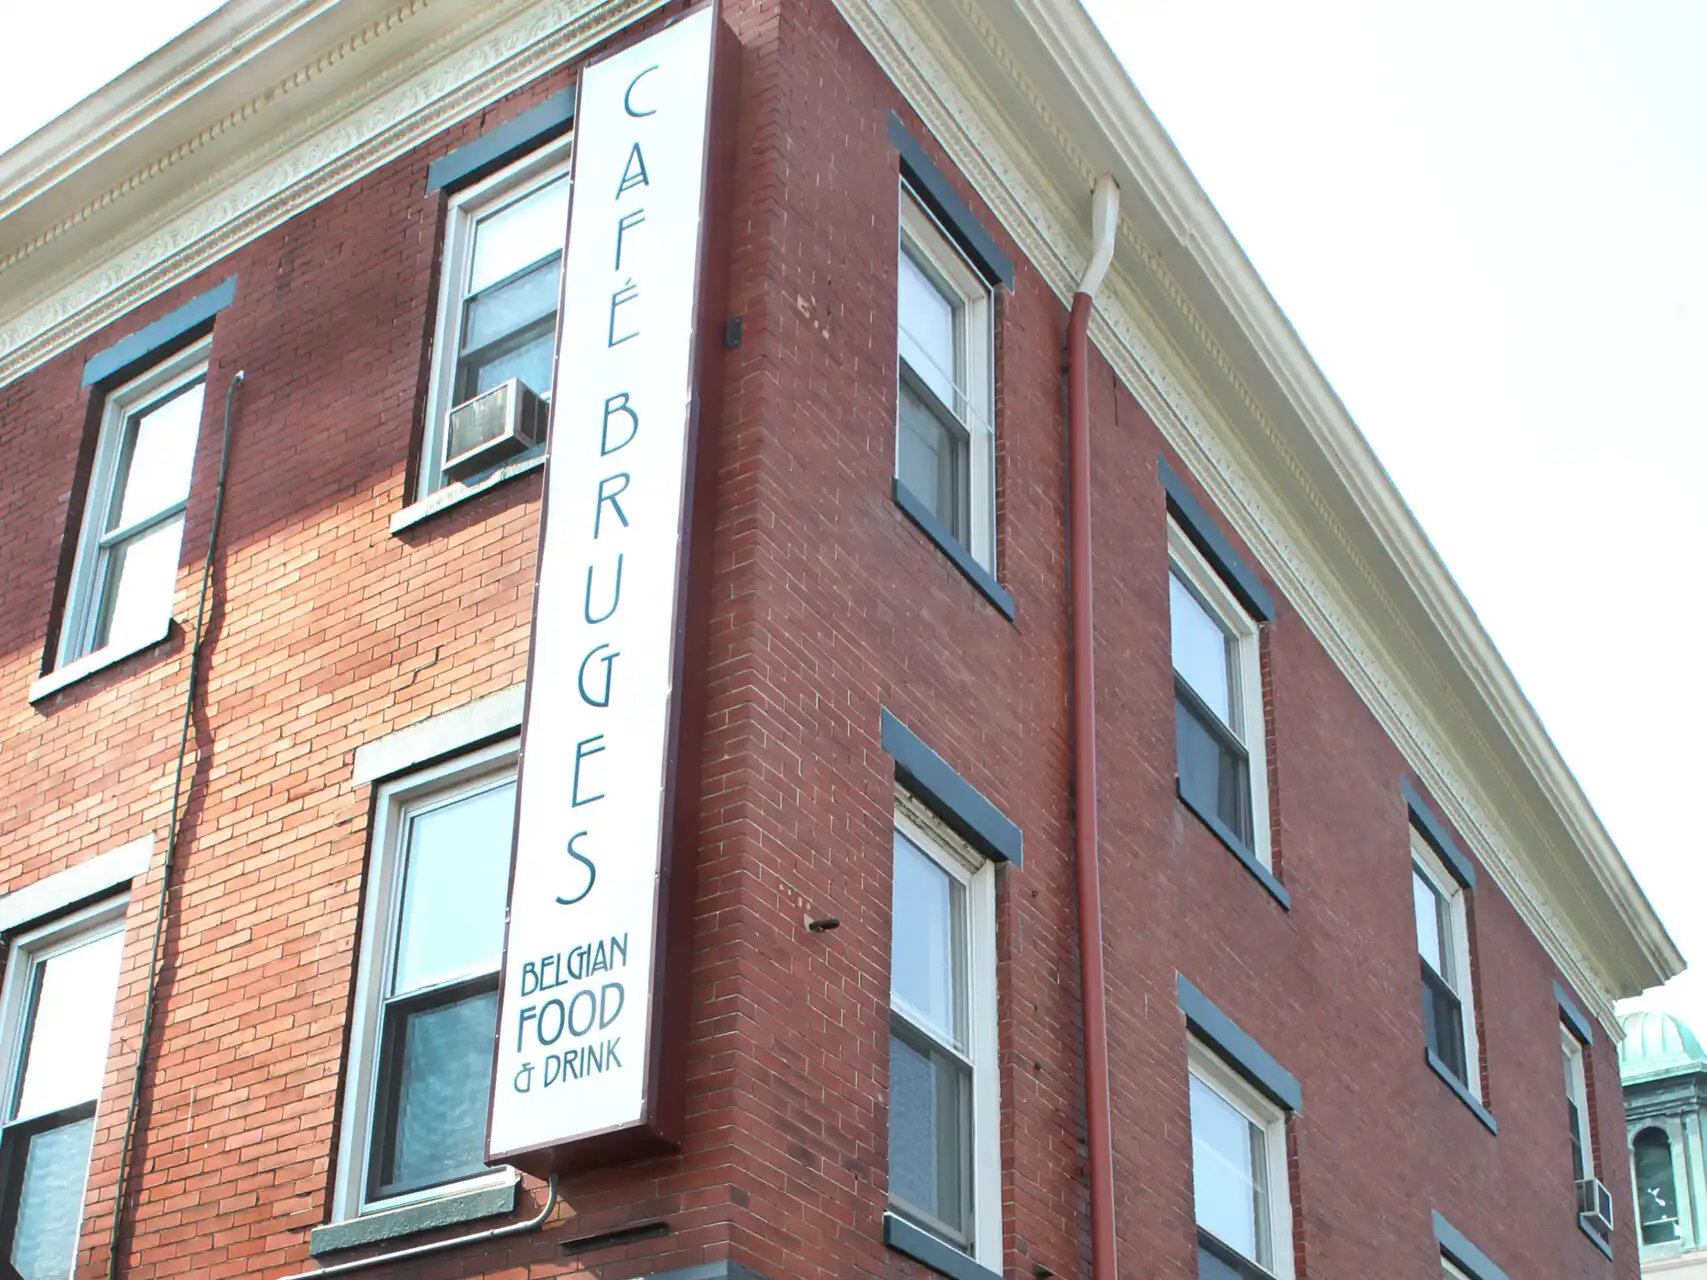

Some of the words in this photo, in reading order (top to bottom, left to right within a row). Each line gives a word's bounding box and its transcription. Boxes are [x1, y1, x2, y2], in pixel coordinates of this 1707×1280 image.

[607, 65, 660, 349] CAFÉ
[555, 392, 639, 905] BRUGES
[520, 931, 629, 998] BELGIAN
[516, 981, 626, 1054] FOOD
[513, 1062, 533, 1095] &
[543, 1036, 624, 1089] DRINK
